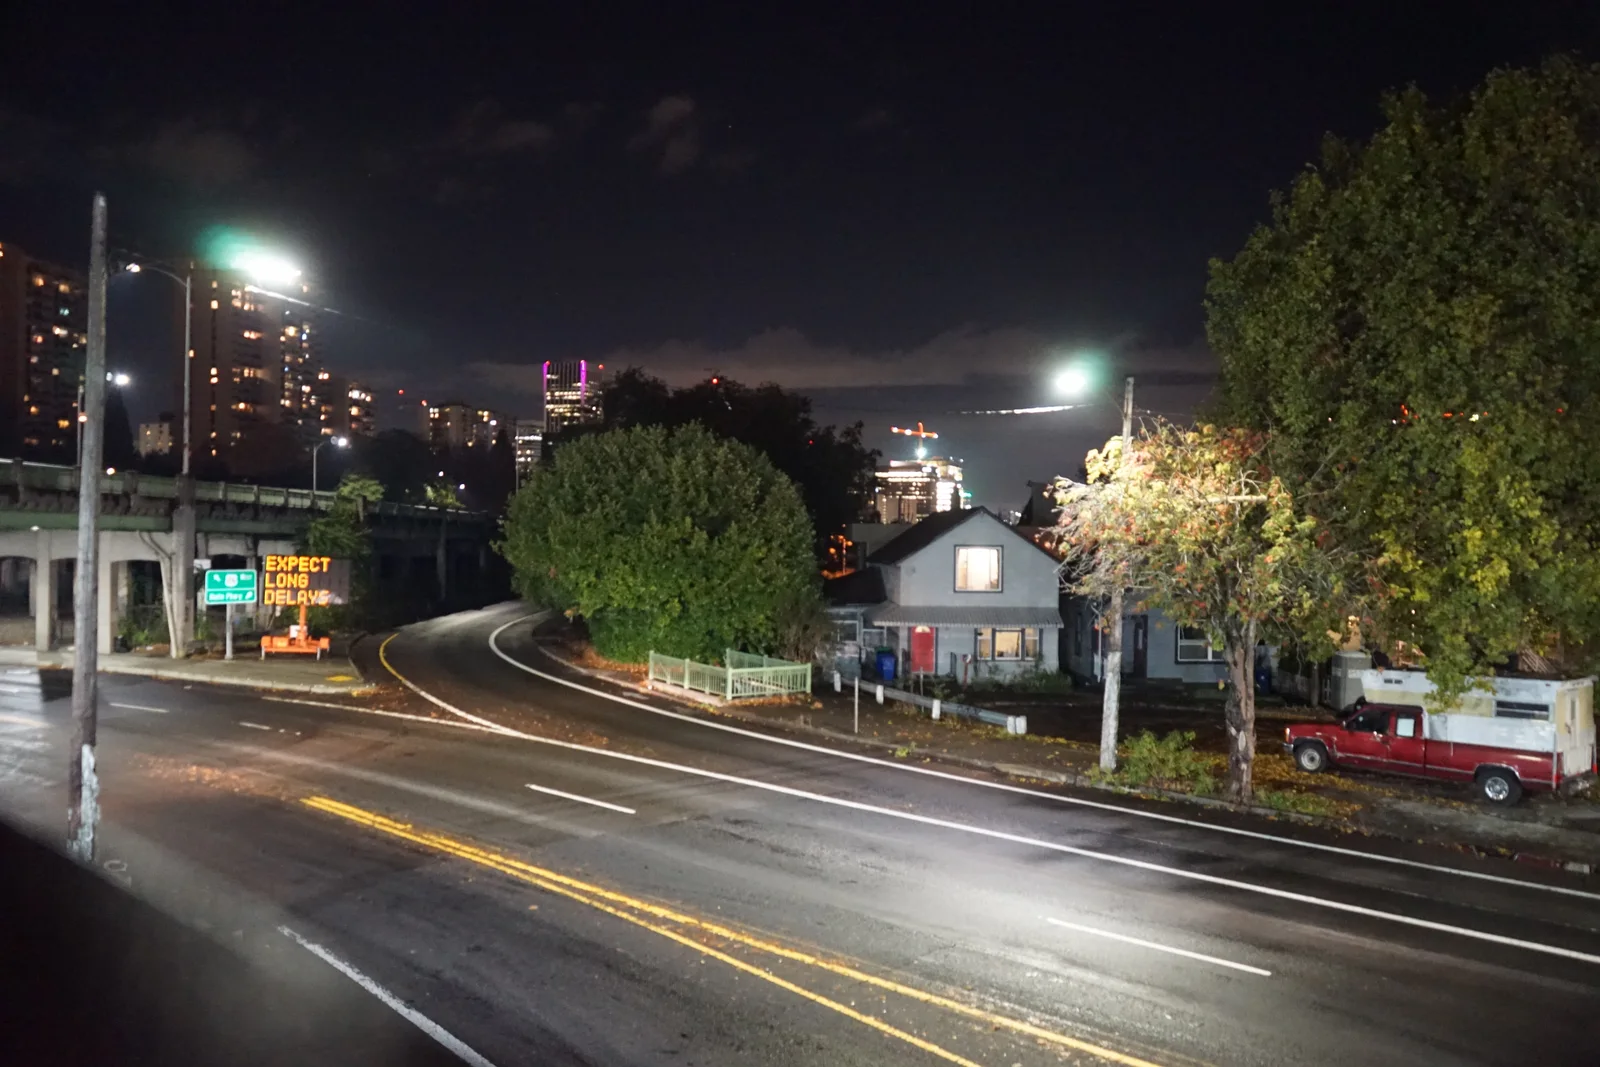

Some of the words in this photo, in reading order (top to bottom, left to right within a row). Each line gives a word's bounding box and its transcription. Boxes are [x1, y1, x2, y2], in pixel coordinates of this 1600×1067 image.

[265, 555, 331, 572] EXPECT
[264, 572, 309, 588] LONG
[263, 589, 330, 606] DELAYS
